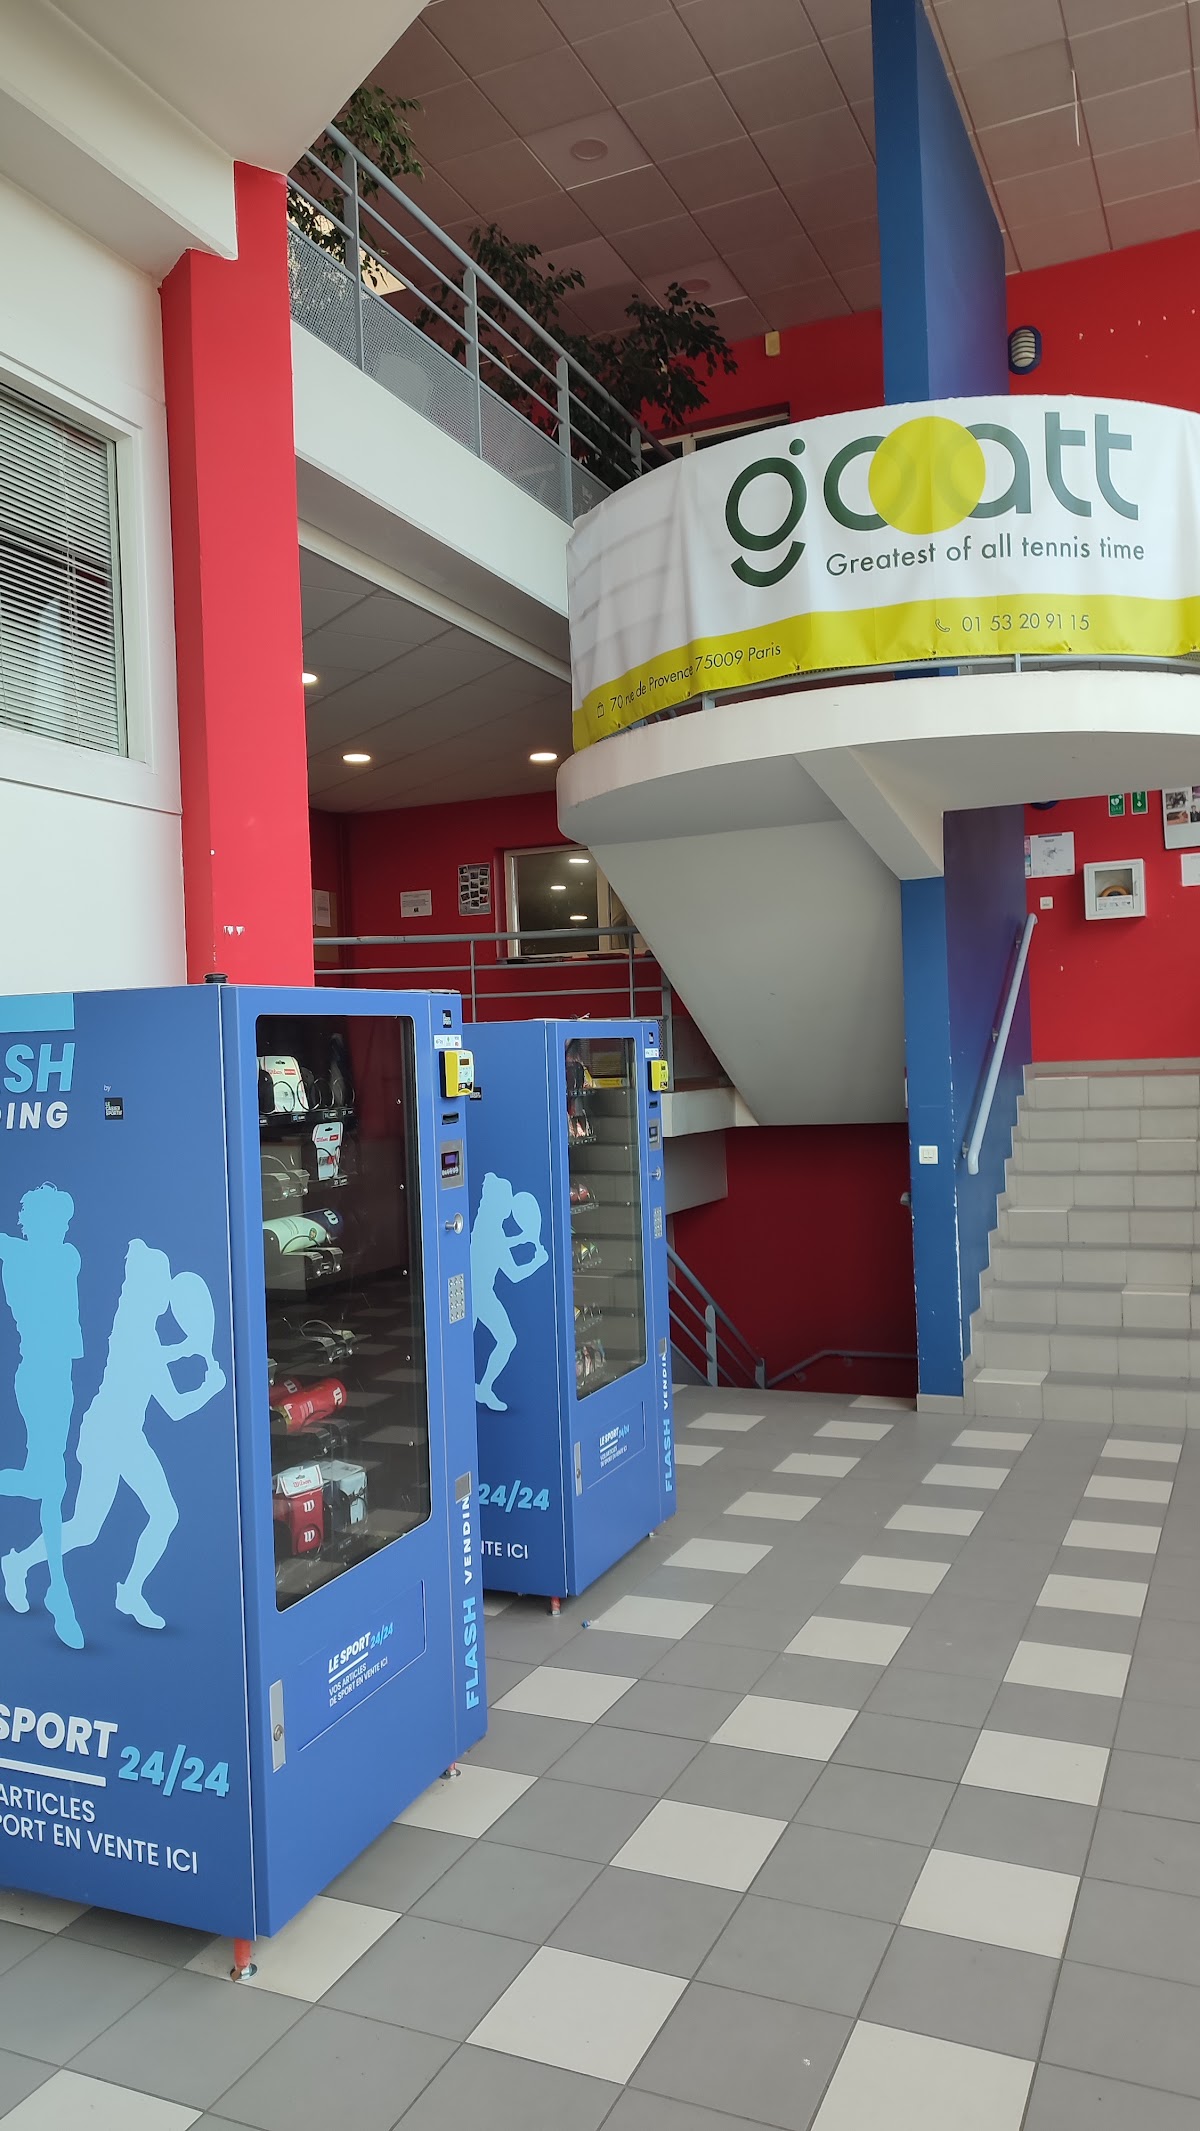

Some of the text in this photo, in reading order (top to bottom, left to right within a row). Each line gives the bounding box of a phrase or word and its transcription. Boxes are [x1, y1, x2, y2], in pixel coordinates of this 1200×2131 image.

[826, 532, 1146, 577] Greatest of all tennis time
[961, 612, 1090, 633] 01 53 20 91 15
[609, 694, 624, 712] 70
[635, 680, 647, 698] de
[648, 665, 694, 692] Provence
[694, 649, 745, 673] 75009
[748, 641, 782, 662] Paris
[3, 1042, 76, 1093] SH
[0, 1100, 69, 1130] ING
[661, 1352, 669, 1411] VENDIN
[663, 1418, 673, 1492] FLASH
[478, 1479, 550, 1513] 24/24
[461, 1496, 473, 1586] VENDIN
[507, 1543, 528, 1560] ICI
[328, 1621, 394, 1674] LE SPORT 24/24
[463, 1596, 480, 1711] FLASH
[329, 1662, 367, 1697] VOS ARTICLES
[329, 1694, 338, 1708] DE
[337, 1681, 356, 1702] SPORT
[355, 1674, 364, 1687] EN
[363, 1661, 381, 1681] VENTE
[0, 1703, 119, 1759] SPORT
[117, 1743, 231, 1798] 24/24
[0, 1783, 97, 1824] ARTICLES
[0, 1813, 199, 1875] ORT EN VENTE ICI
